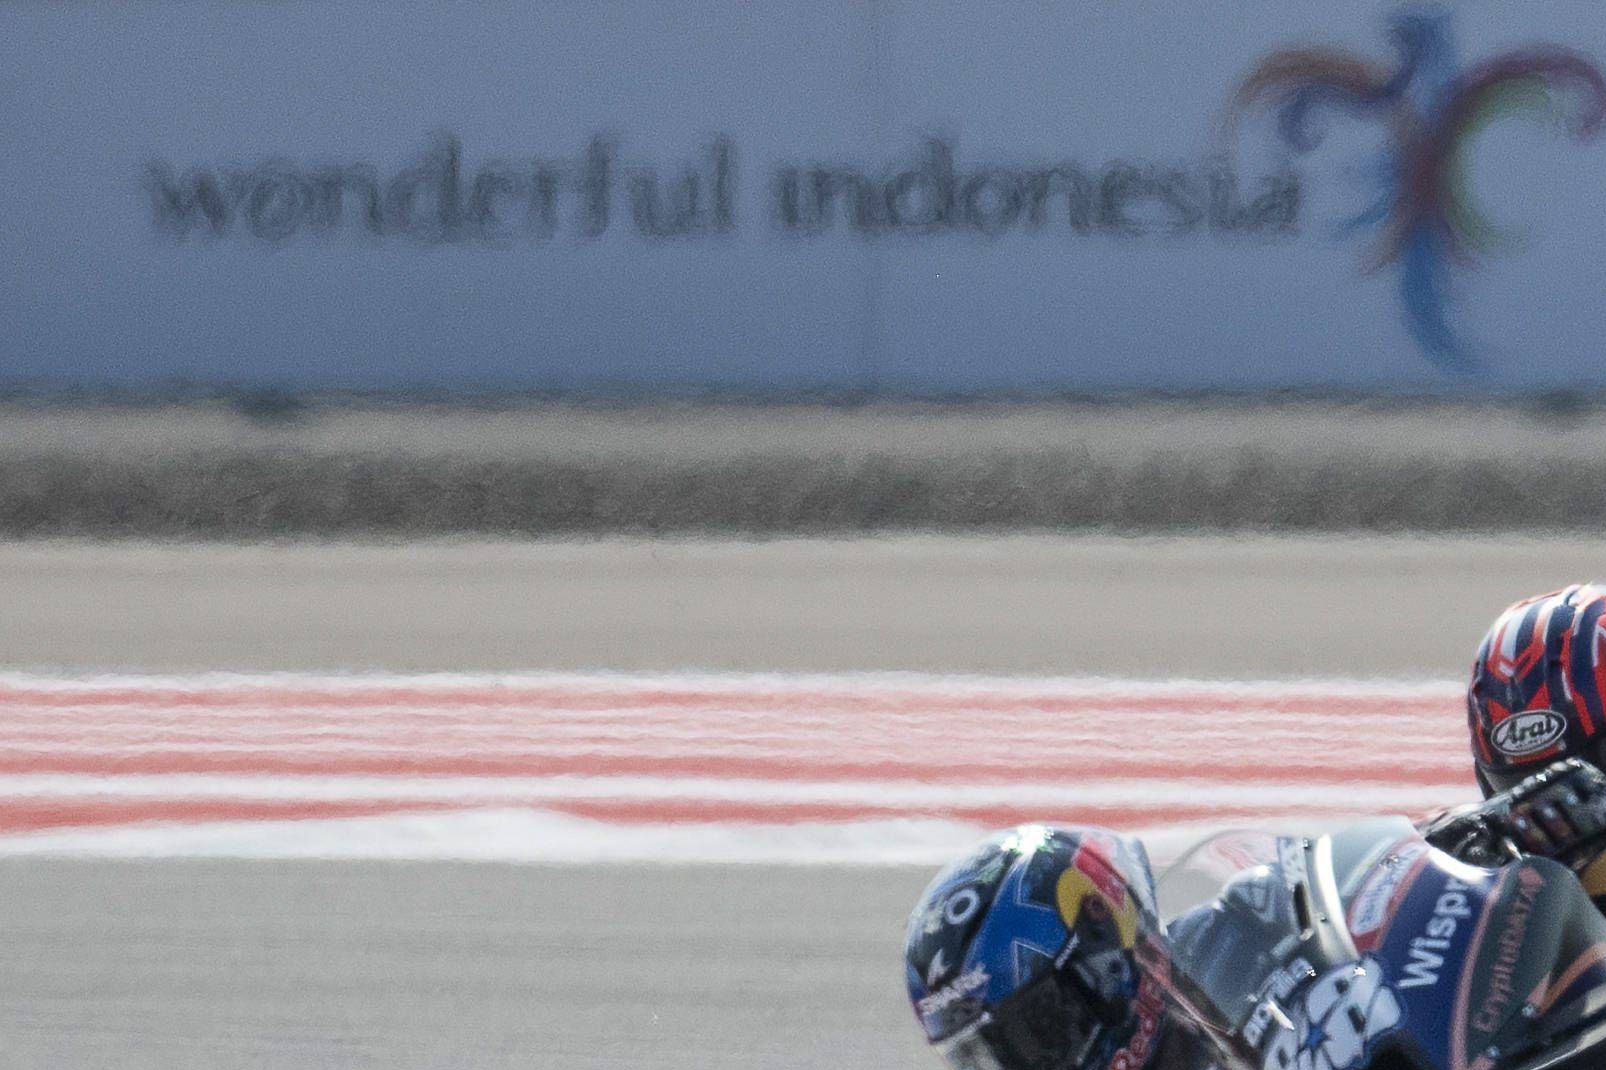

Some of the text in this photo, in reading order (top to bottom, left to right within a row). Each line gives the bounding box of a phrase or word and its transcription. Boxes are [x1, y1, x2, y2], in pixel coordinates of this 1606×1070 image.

[146, 128, 1303, 246] wonderful indonesia
[1497, 714, 1557, 743] Arai
[1396, 876, 1473, 989] Wispr
